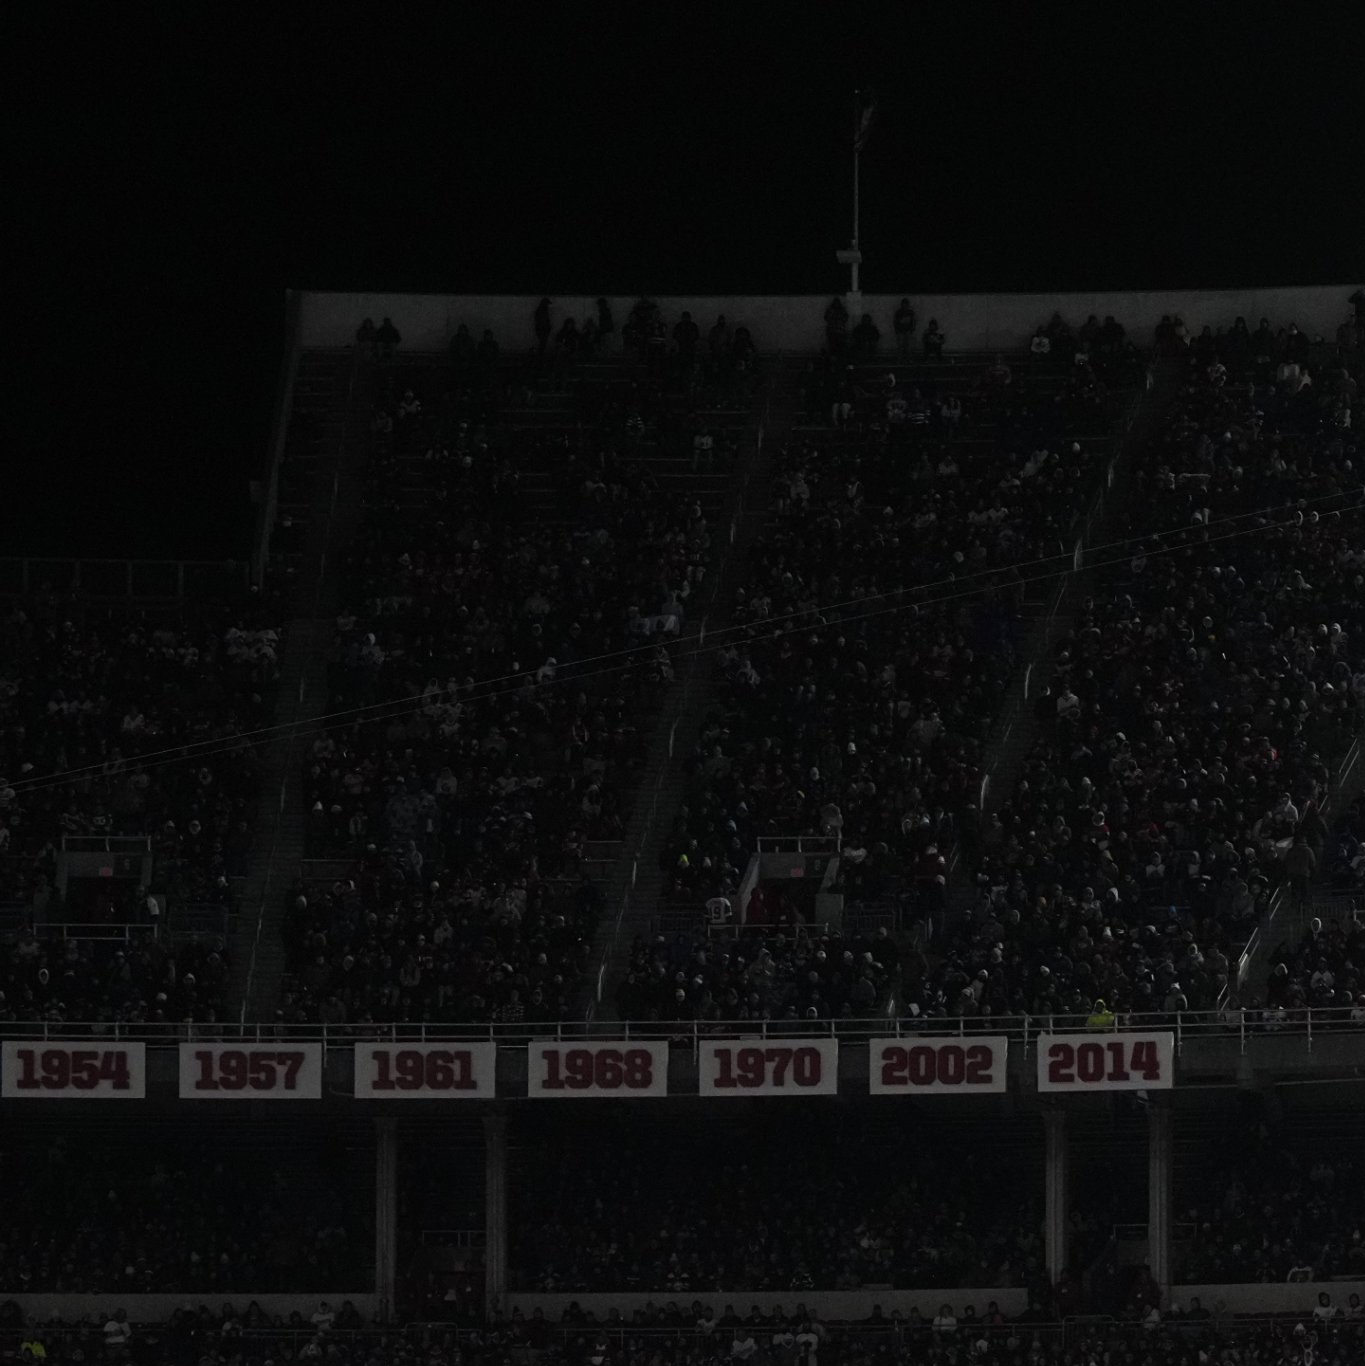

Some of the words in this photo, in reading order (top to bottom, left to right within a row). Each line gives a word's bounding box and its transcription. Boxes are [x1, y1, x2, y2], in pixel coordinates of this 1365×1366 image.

[16, 1050, 130, 1090] 1954
[195, 1051, 305, 1091] 1957
[371, 1050, 477, 1091] 1961
[541, 1049, 653, 1089] 1968
[713, 1047, 821, 1088] 1970
[880, 1045, 993, 1085] 2002
[1048, 1041, 1160, 1083] 2014
